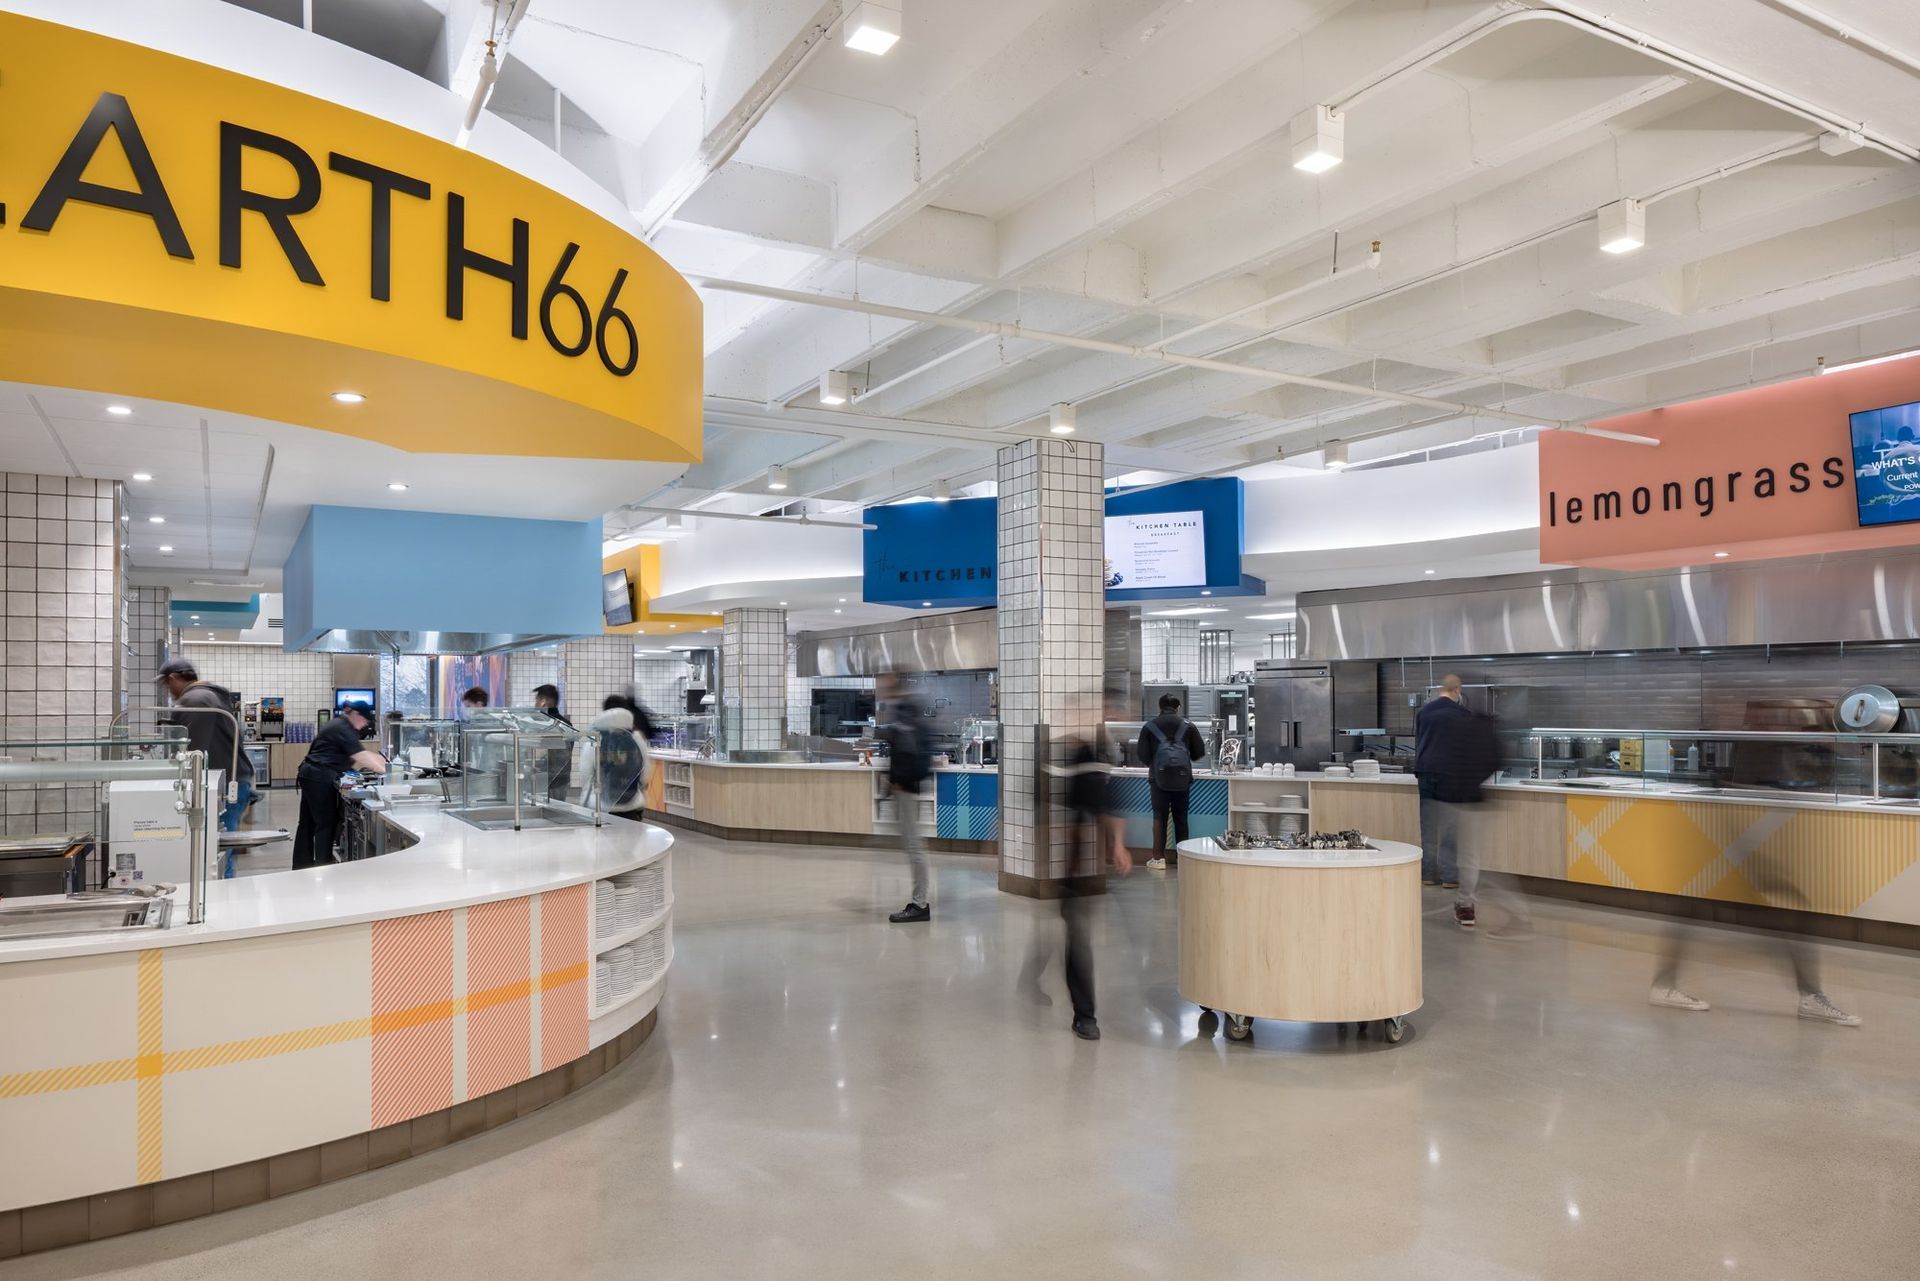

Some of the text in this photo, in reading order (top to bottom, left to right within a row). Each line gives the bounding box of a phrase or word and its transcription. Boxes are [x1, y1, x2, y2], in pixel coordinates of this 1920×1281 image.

[0, 91, 639, 377] ARTH66
[1871, 456, 1916, 471] WHAT'S
[1886, 471, 1918, 482] Current
[1549, 456, 1845, 527] lemongrass
[899, 566, 992, 583] KITCHEN
